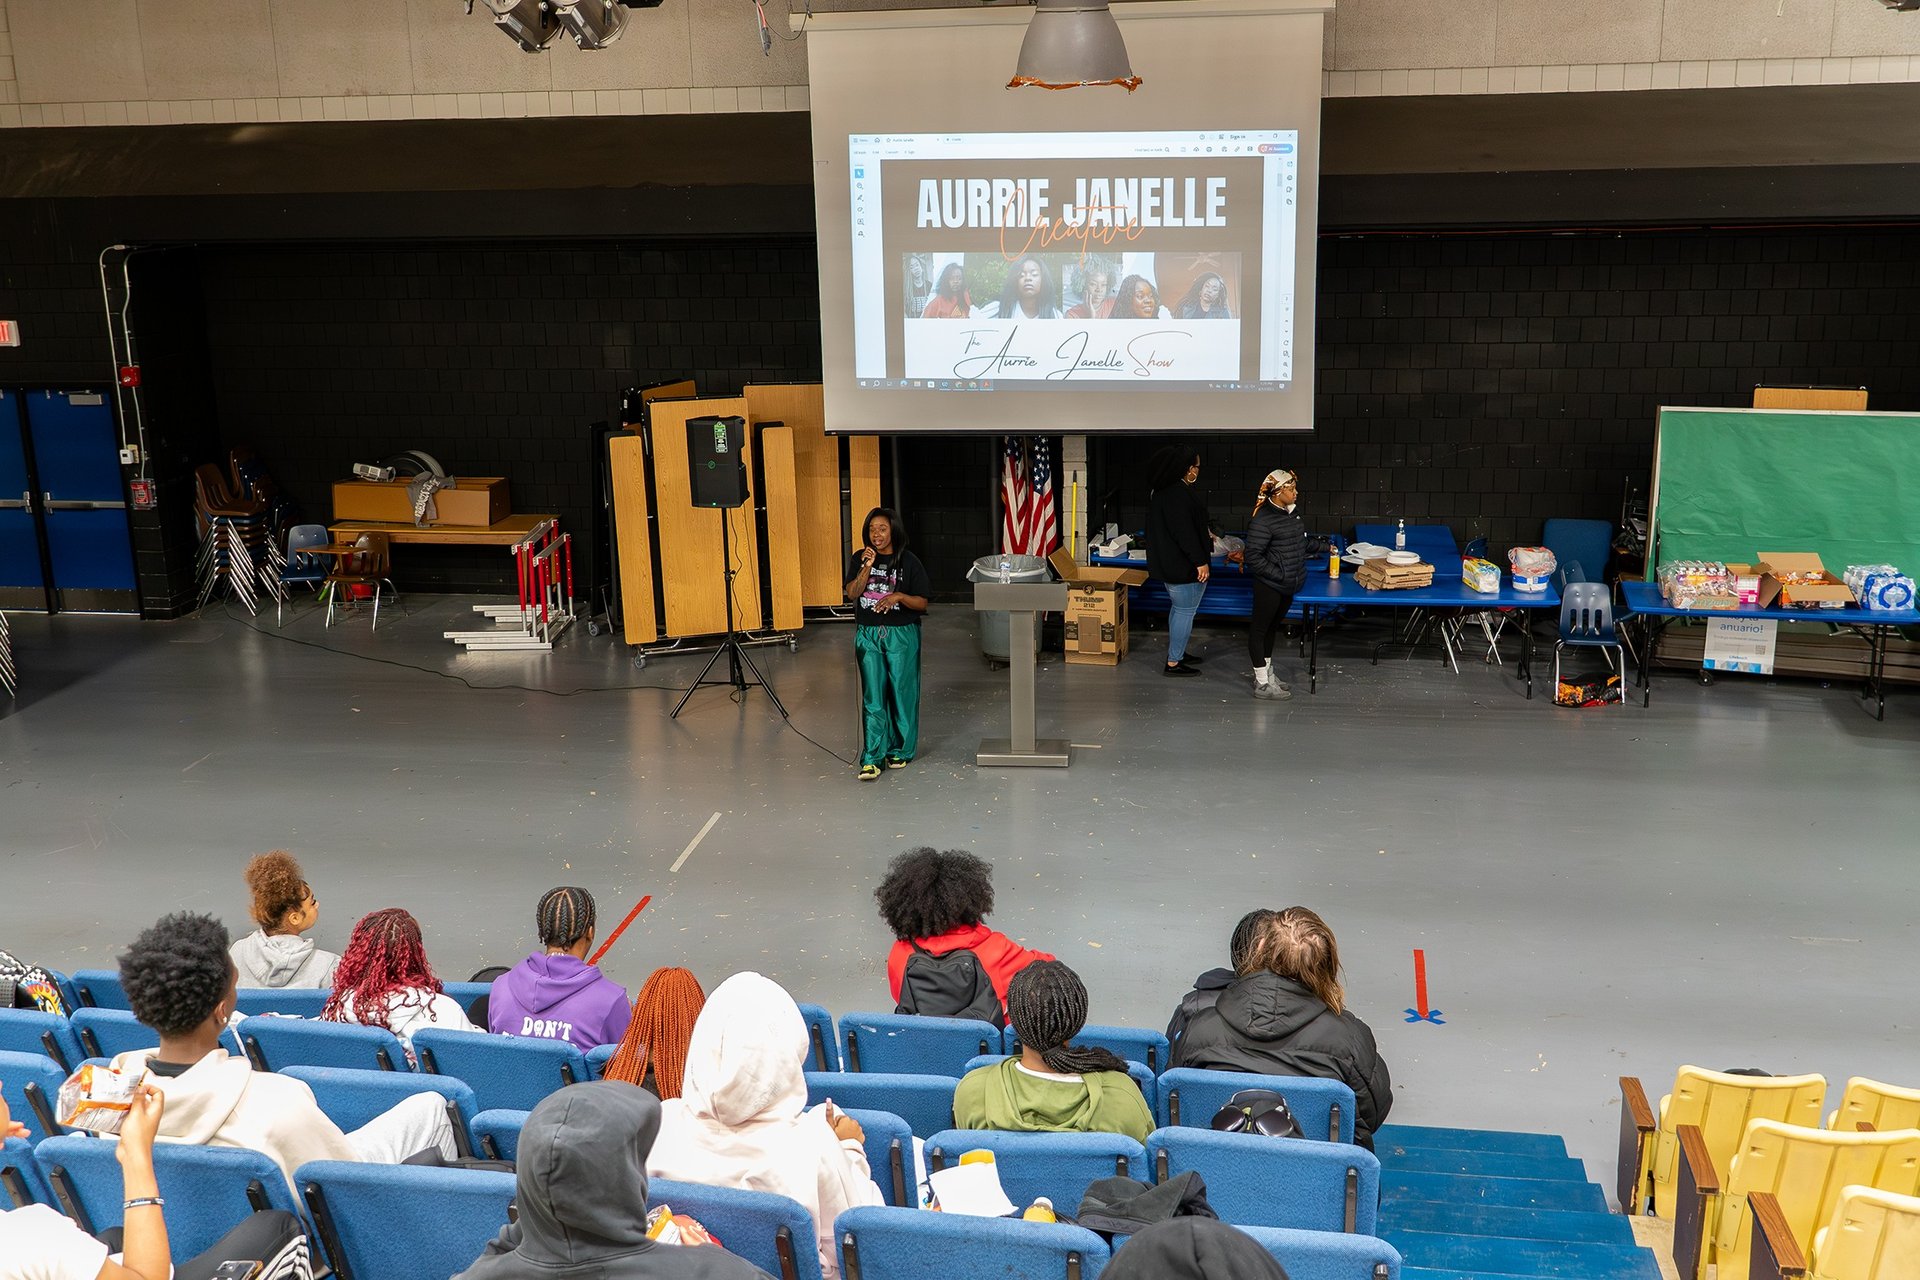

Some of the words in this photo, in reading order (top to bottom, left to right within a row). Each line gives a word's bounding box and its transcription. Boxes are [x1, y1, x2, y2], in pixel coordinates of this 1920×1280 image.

[917, 178, 1049, 228] AURRIE
[1063, 177, 1227, 227] JANELLE
[1000, 186, 1146, 269] Creative
[953, 325, 1038, 380] Aurrie
[1046, 331, 1124, 380] Janelle
[1127, 330, 1193, 377] Show
[959, 329, 999, 354] The
[1720, 623, 1764, 633] anuario!
[520, 1016, 572, 1041] DON'T
